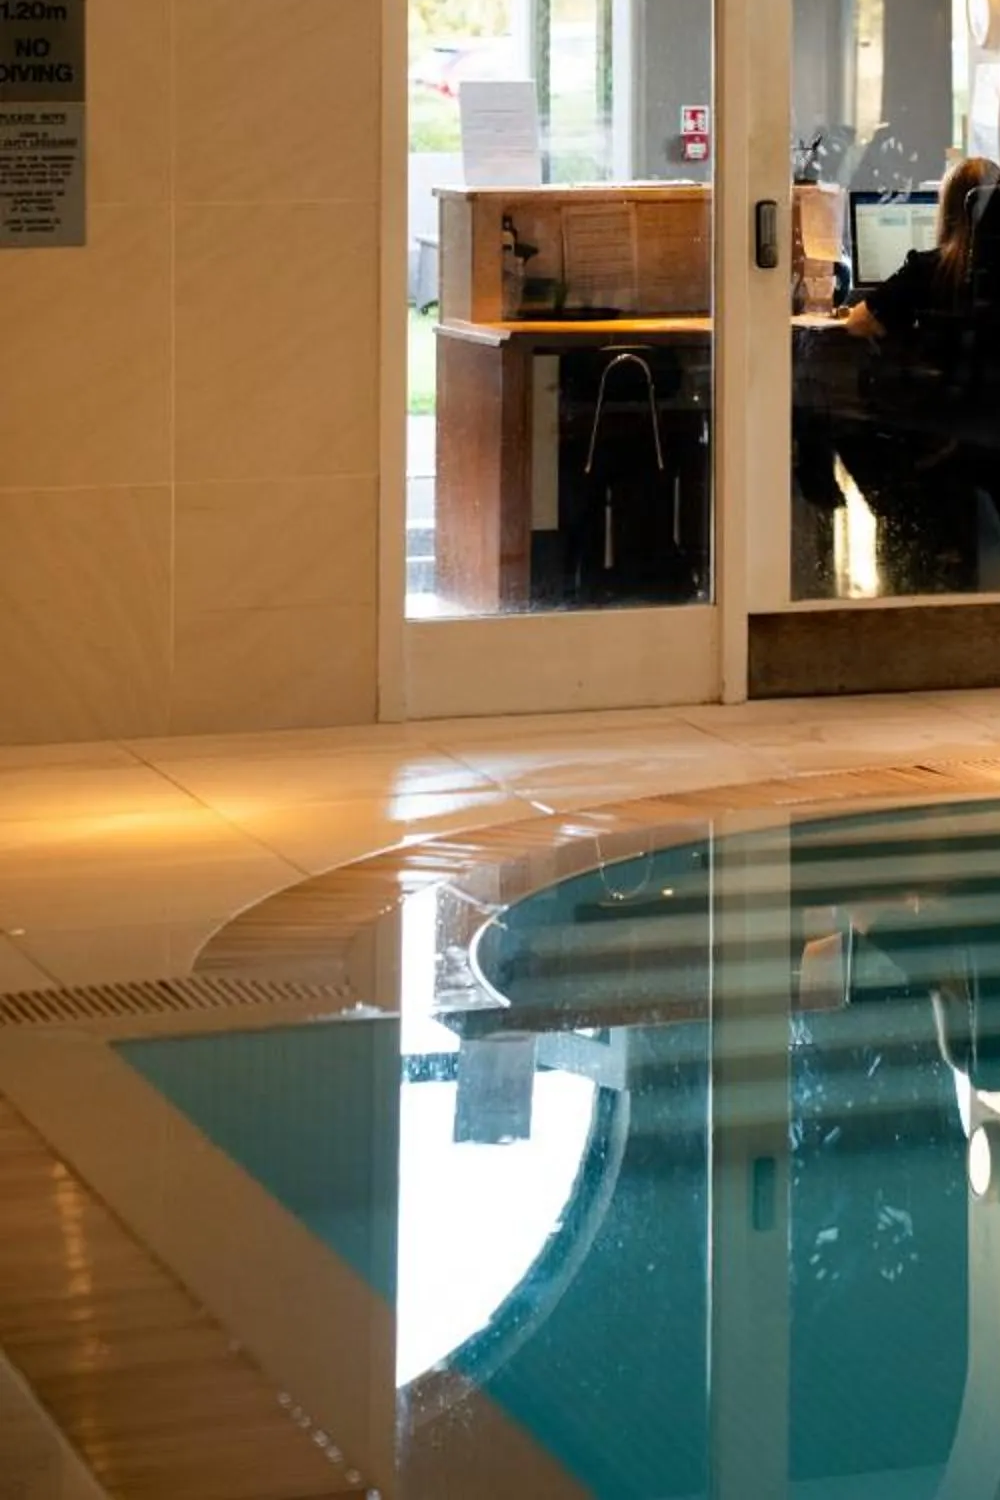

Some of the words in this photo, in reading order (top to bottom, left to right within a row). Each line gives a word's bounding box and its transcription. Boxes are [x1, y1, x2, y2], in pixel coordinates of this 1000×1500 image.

[0, 1, 67, 20] 1.20m
[14, 38, 51, 57] NO
[0, 63, 73, 83] DIVING
